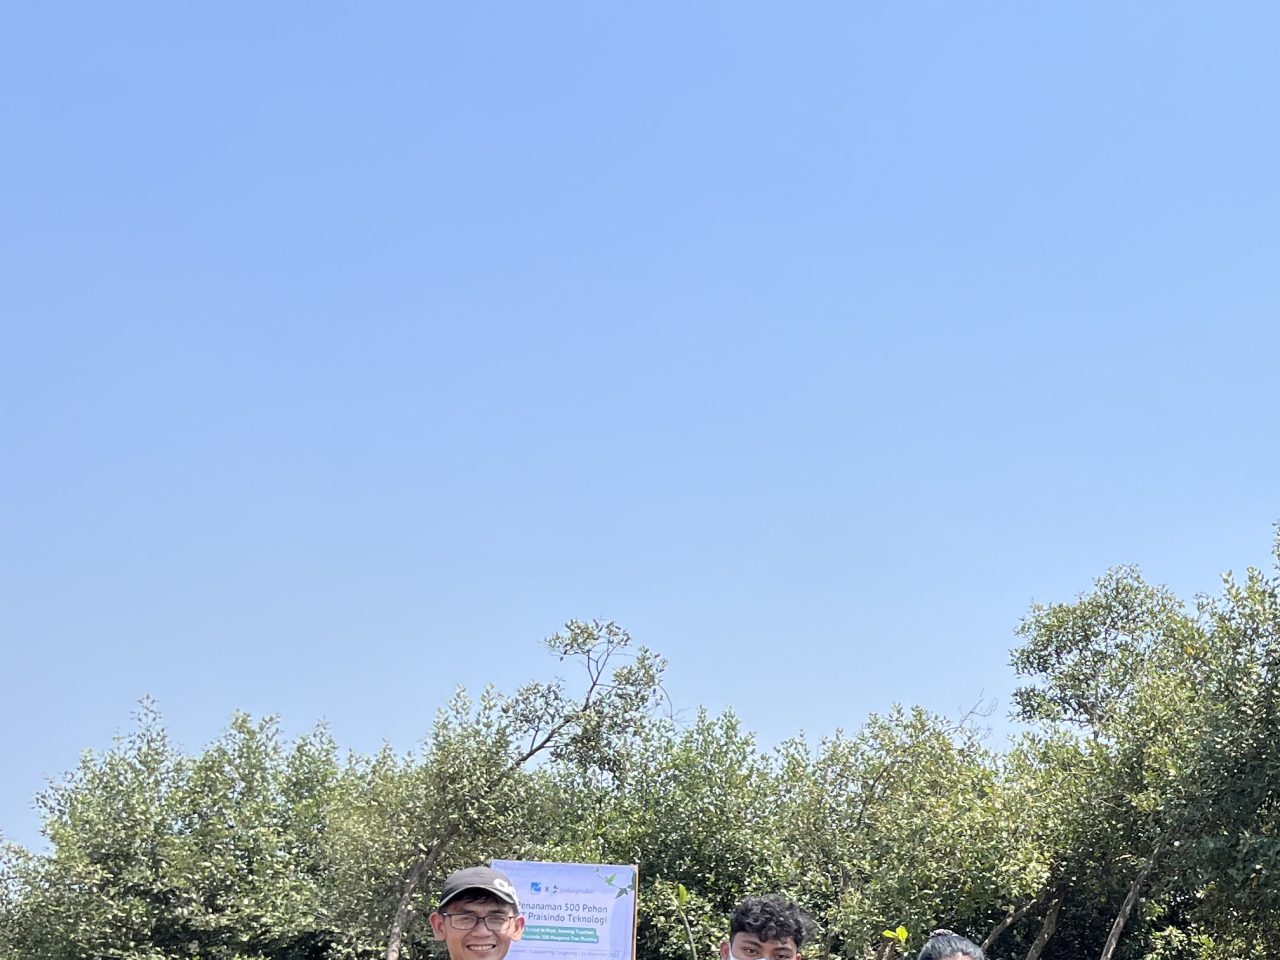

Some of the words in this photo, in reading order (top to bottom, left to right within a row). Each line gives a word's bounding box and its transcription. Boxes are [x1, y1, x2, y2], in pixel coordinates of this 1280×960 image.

[564, 903, 580, 912] 500
[582, 904, 608, 913] Pohon
[528, 912, 565, 922] Praisindo
[568, 914, 607, 926] Teknologi
